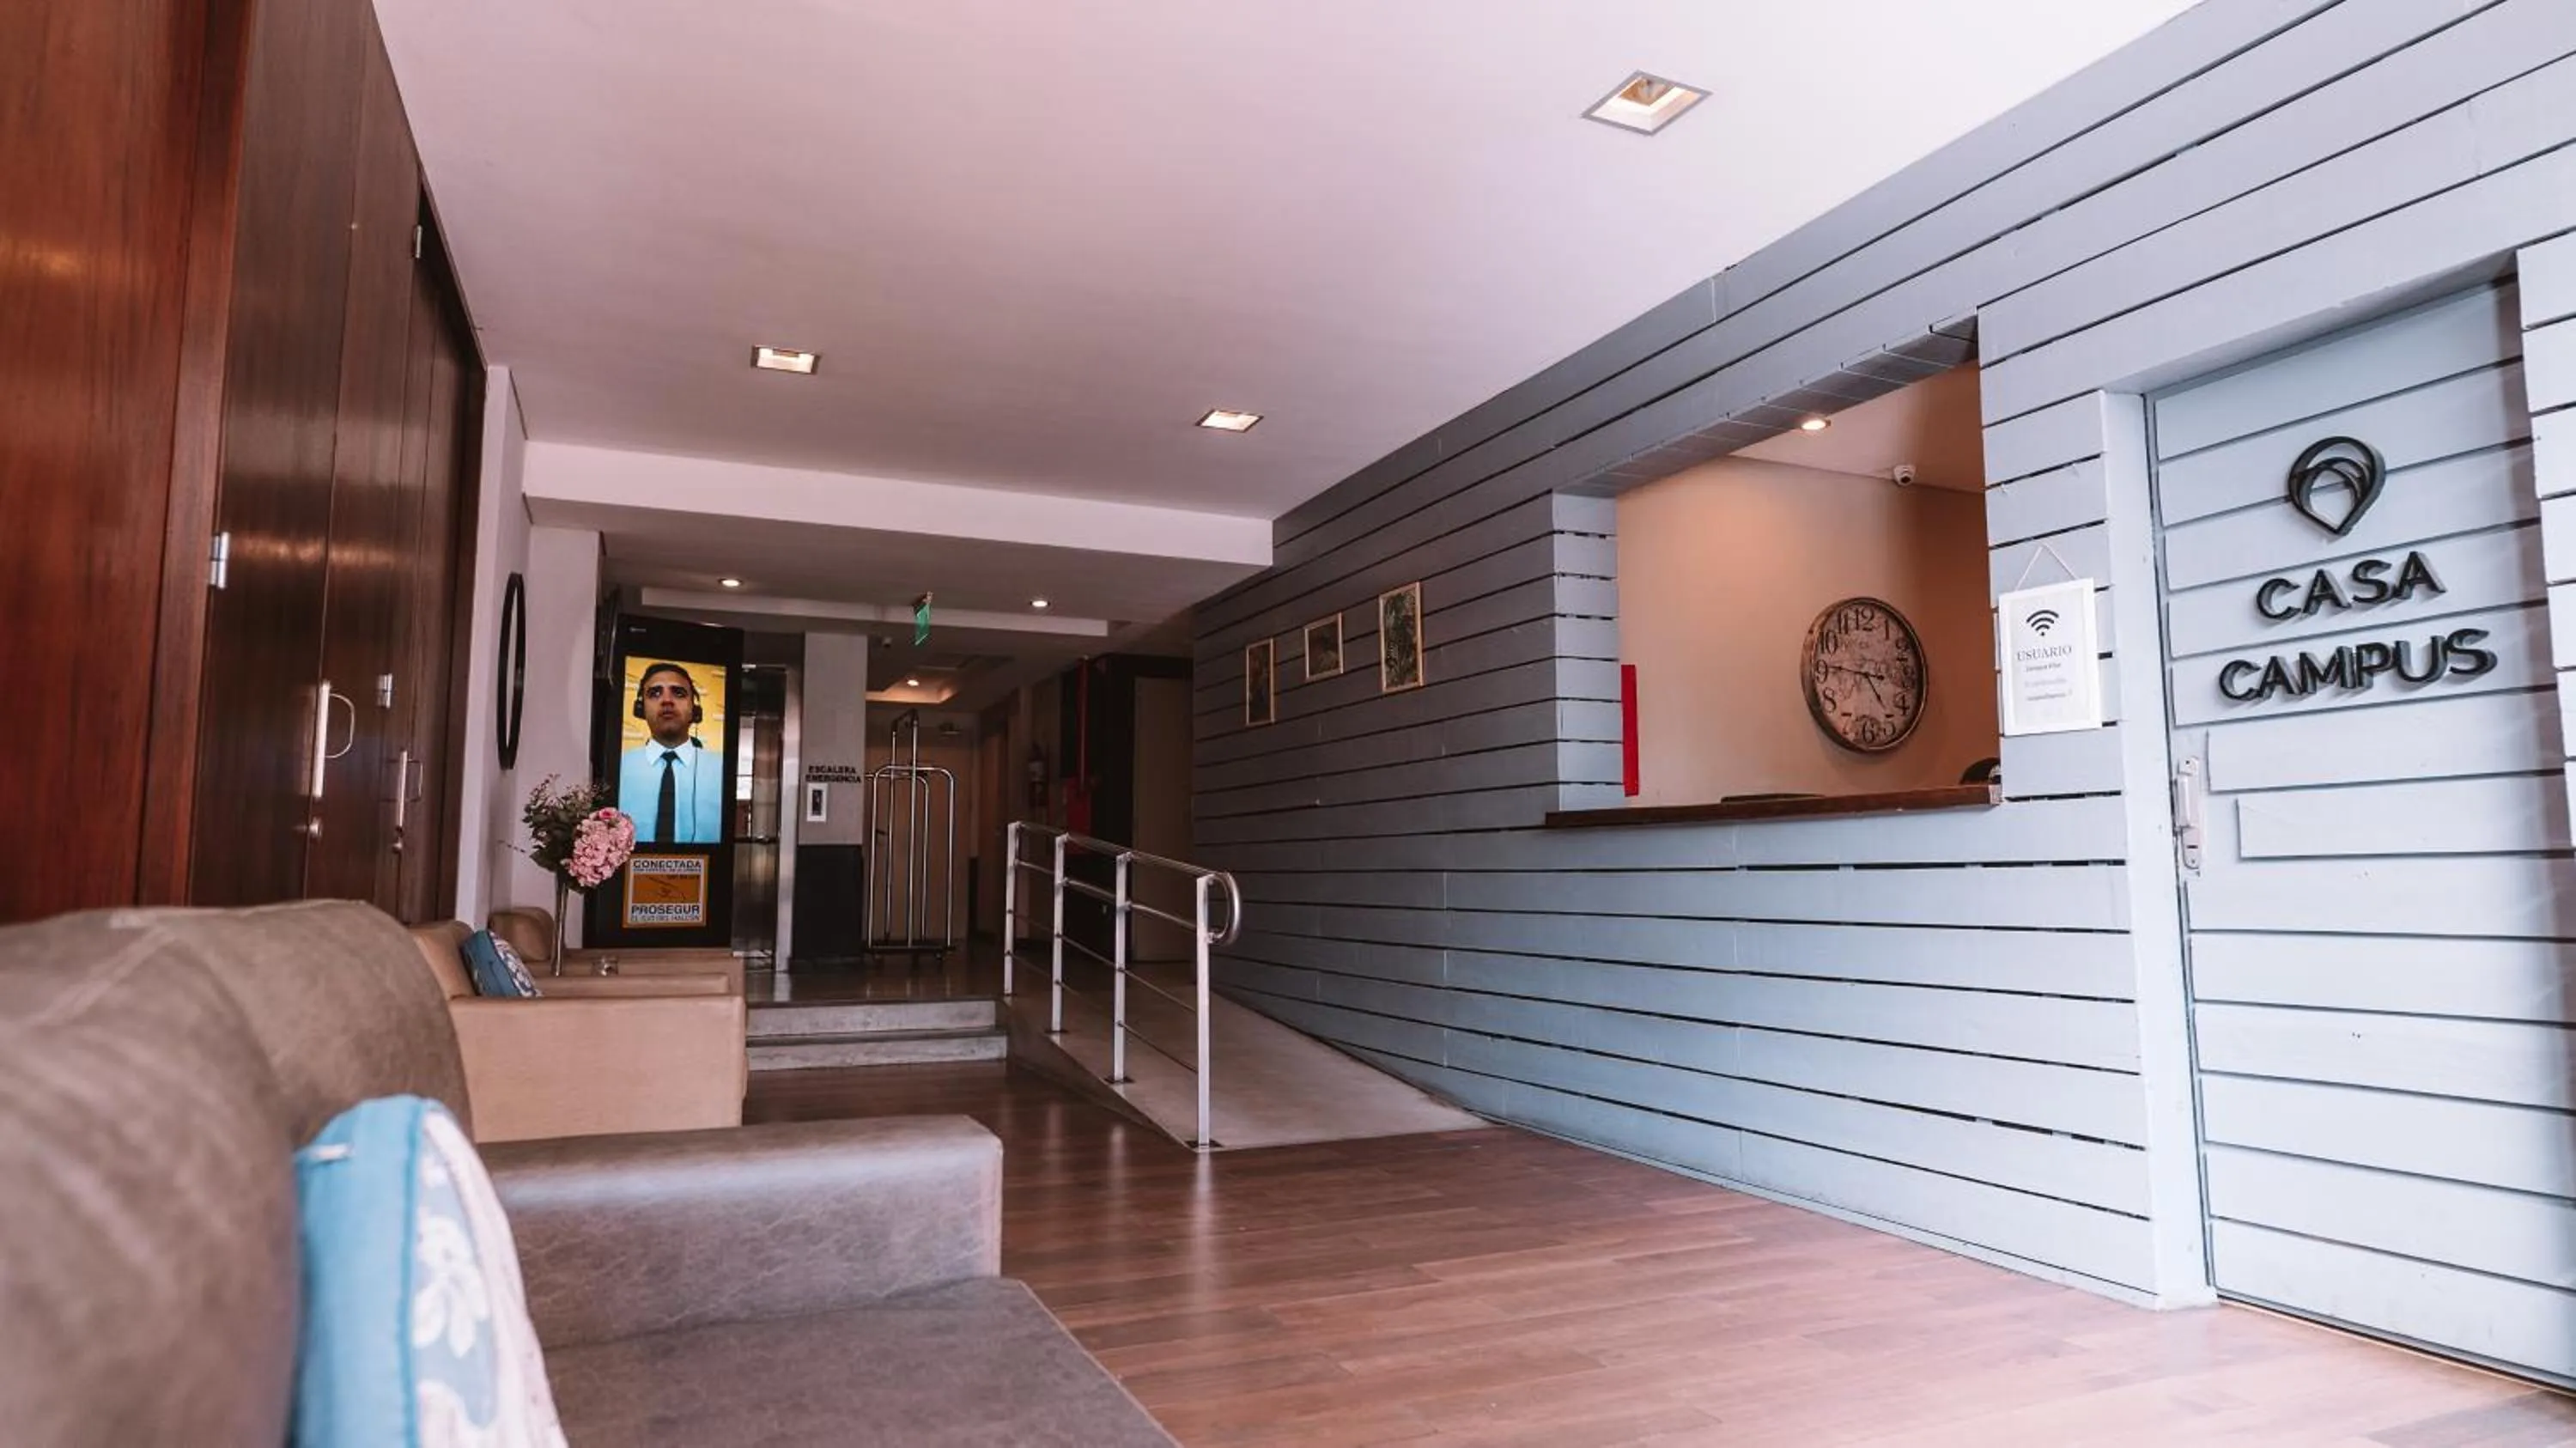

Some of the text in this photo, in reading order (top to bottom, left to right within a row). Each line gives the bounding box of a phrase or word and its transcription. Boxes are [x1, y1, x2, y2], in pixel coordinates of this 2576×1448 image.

[2257, 551, 2446, 619] CASA
[1855, 606, 1874, 632] 12
[1883, 618, 1890, 641] 1
[1819, 630, 1838, 656] 10
[2017, 645, 2073, 661] USUARIO
[1815, 658, 1828, 684] 9
[2219, 628, 2497, 701] CAMPUS
[1822, 686, 1837, 714] 8
[1893, 690, 1910, 716] 4
[1862, 720, 1875, 744] 6
[805, 775, 862, 783] EMERGENCIA
[809, 765, 856, 774] ESCALERA
[633, 860, 702, 868] CONECTADA
[631, 904, 700, 915] PROSEGUR
